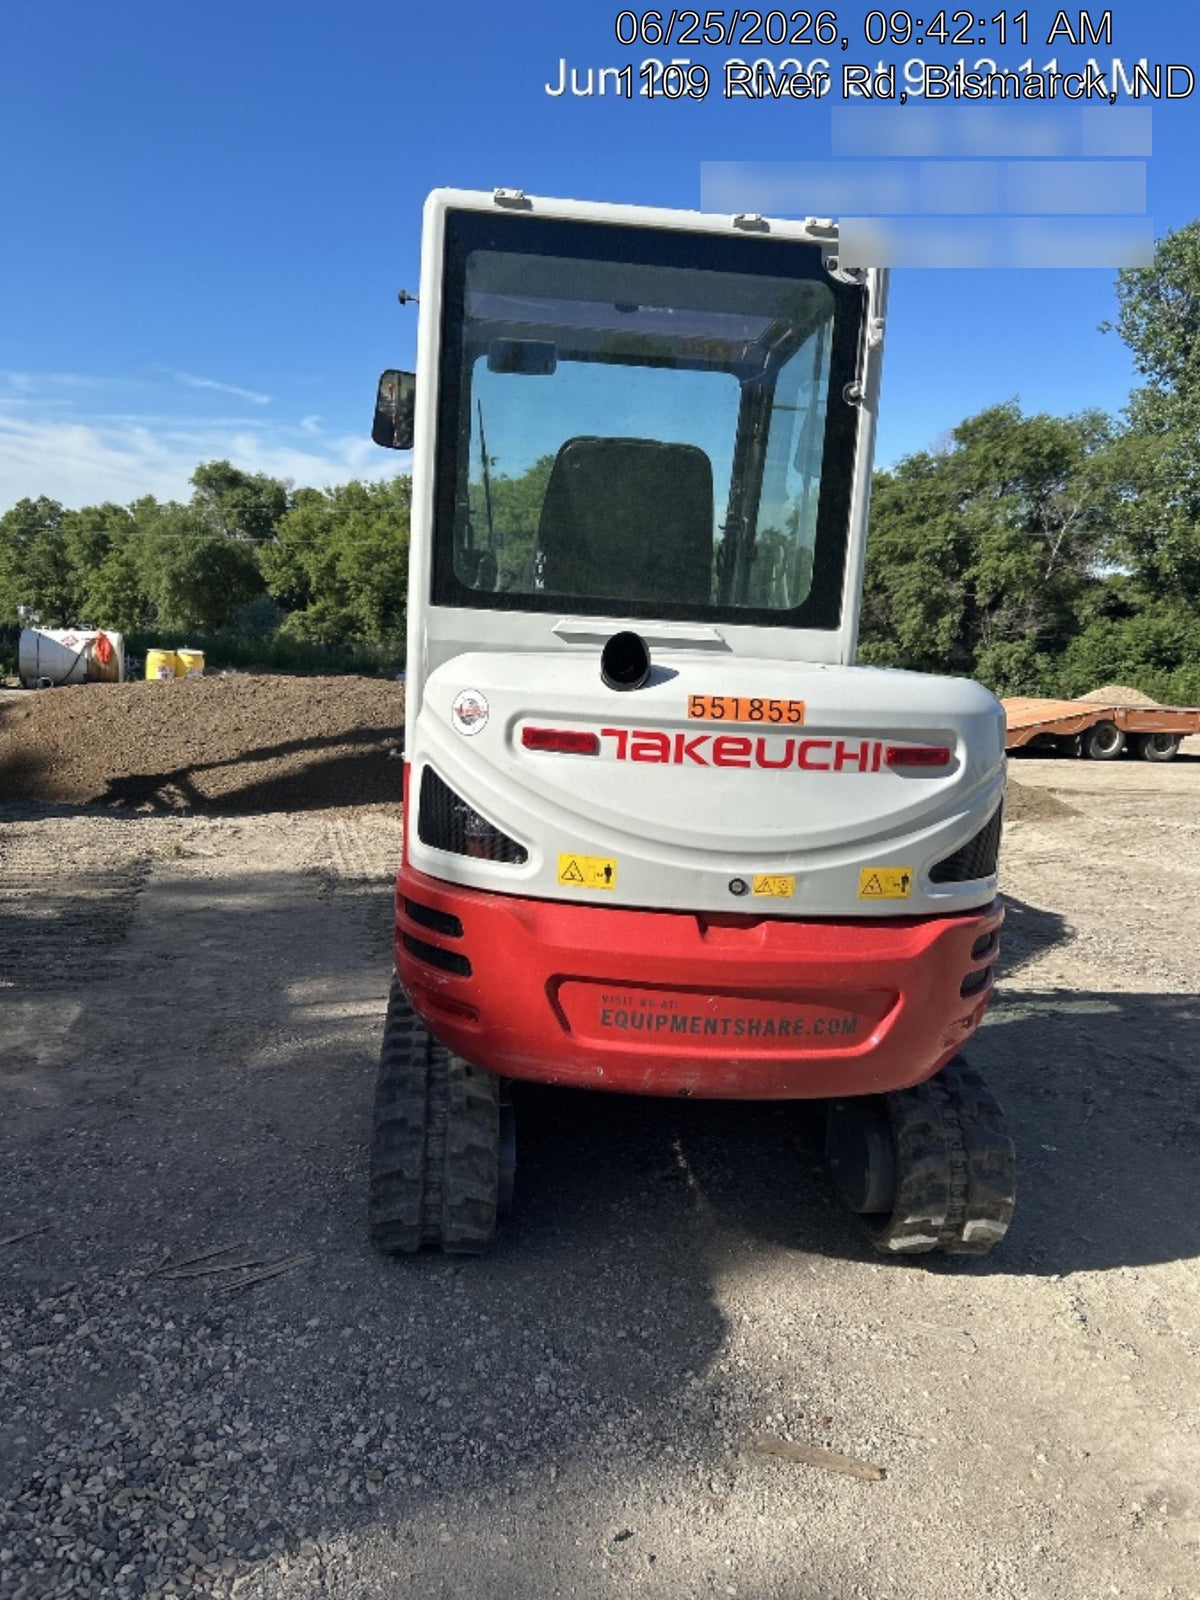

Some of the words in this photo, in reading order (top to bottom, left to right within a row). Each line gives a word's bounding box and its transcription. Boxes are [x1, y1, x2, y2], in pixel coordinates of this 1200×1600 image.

[691, 695, 801, 723] 551855
[600, 728, 882, 772] TAKEUCHI
[601, 1008, 858, 1036] EQUIPMENTSHARE.COM
